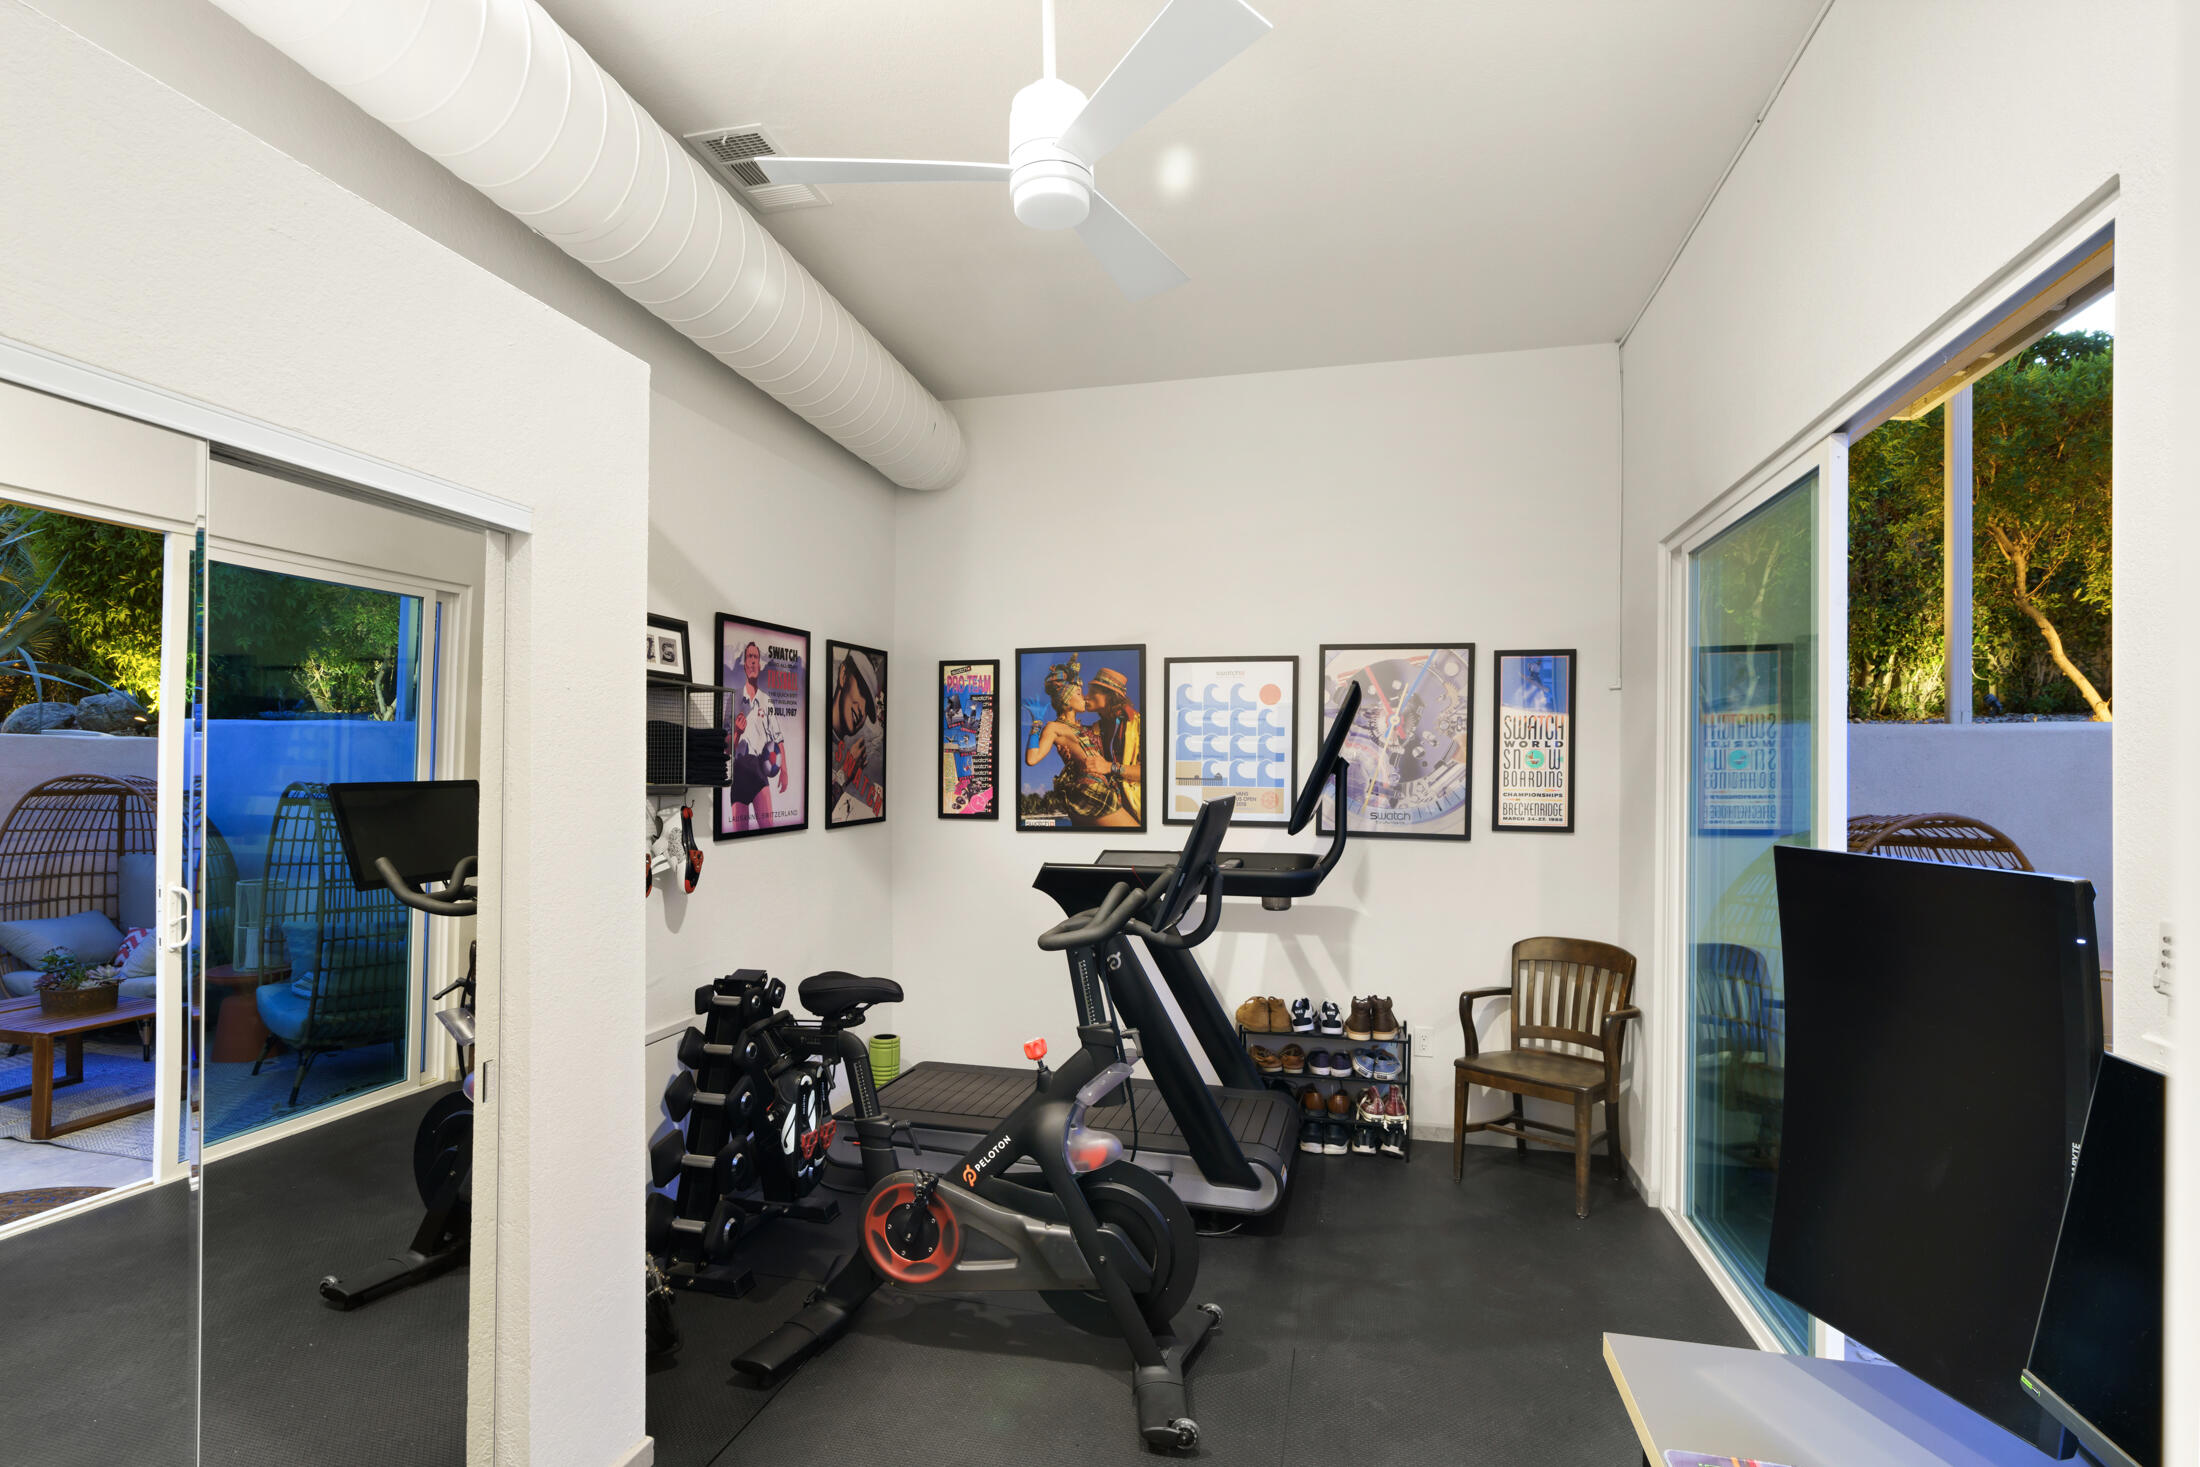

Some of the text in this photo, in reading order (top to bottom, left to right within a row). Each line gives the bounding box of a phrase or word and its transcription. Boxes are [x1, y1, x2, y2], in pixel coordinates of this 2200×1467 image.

[768, 645, 798, 662] SWATCH
[768, 669, 799, 692] FUSSBALL
[946, 674, 992, 694] PRO-TEAM
[1503, 714, 1565, 740] SWATCH
[1503, 740, 1564, 748] WORLD
[835, 740, 883, 817] SWATCH
[1503, 770, 1563, 788] BOARDING
[761, 809, 799, 820] SWITZERLAND
[1369, 810, 1411, 821] swatch
[1502, 802, 1563, 817] BRECKENRIDGE
[974, 1134, 1012, 1172] PELOTON
